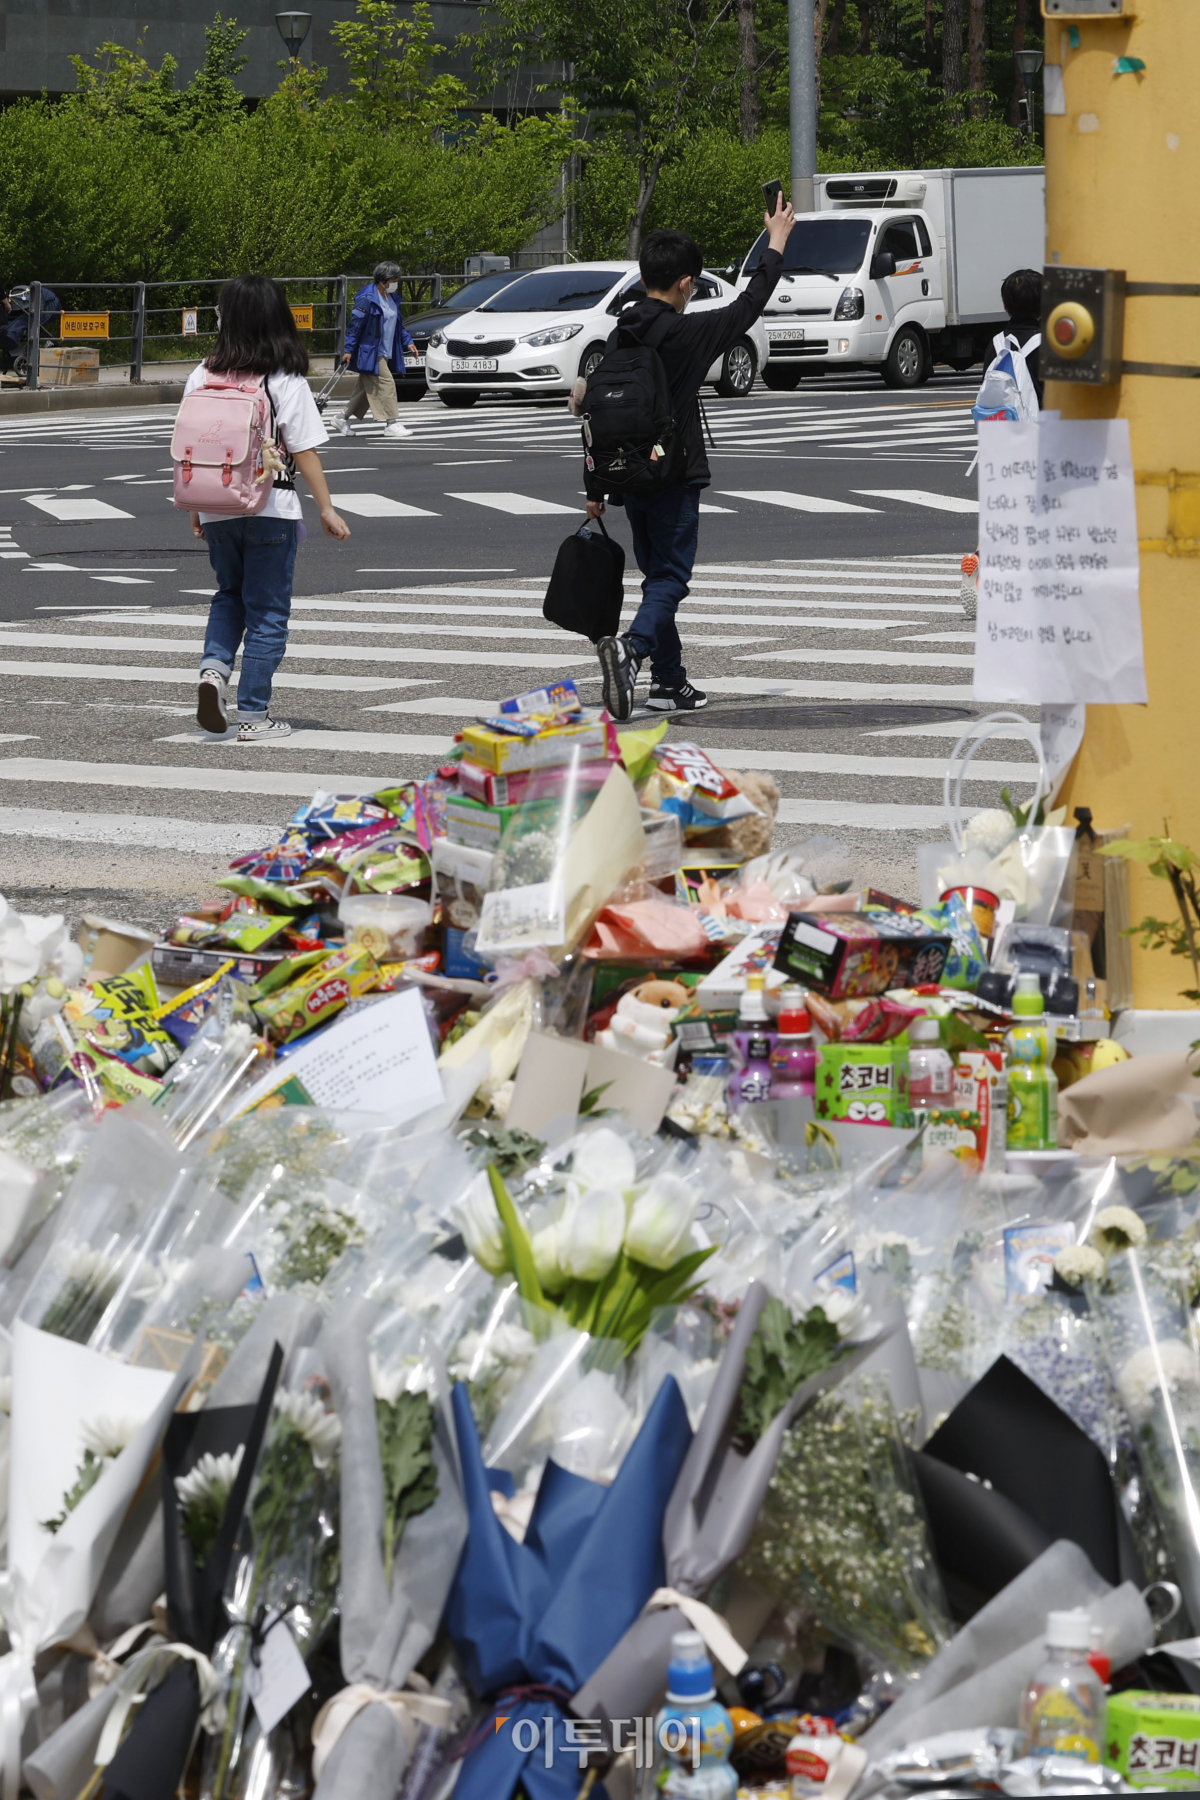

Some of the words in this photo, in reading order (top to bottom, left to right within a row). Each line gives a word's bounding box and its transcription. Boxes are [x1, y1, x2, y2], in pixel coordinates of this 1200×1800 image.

[295, 315, 310, 323] ZONE
[65, 321, 105, 331] 어린이보호구역
[782, 330, 801, 340] 2902
[473, 361, 492, 370] 4183
[307, 979, 350, 1012] 초코송이
[840, 1064, 894, 1092] 초코비
